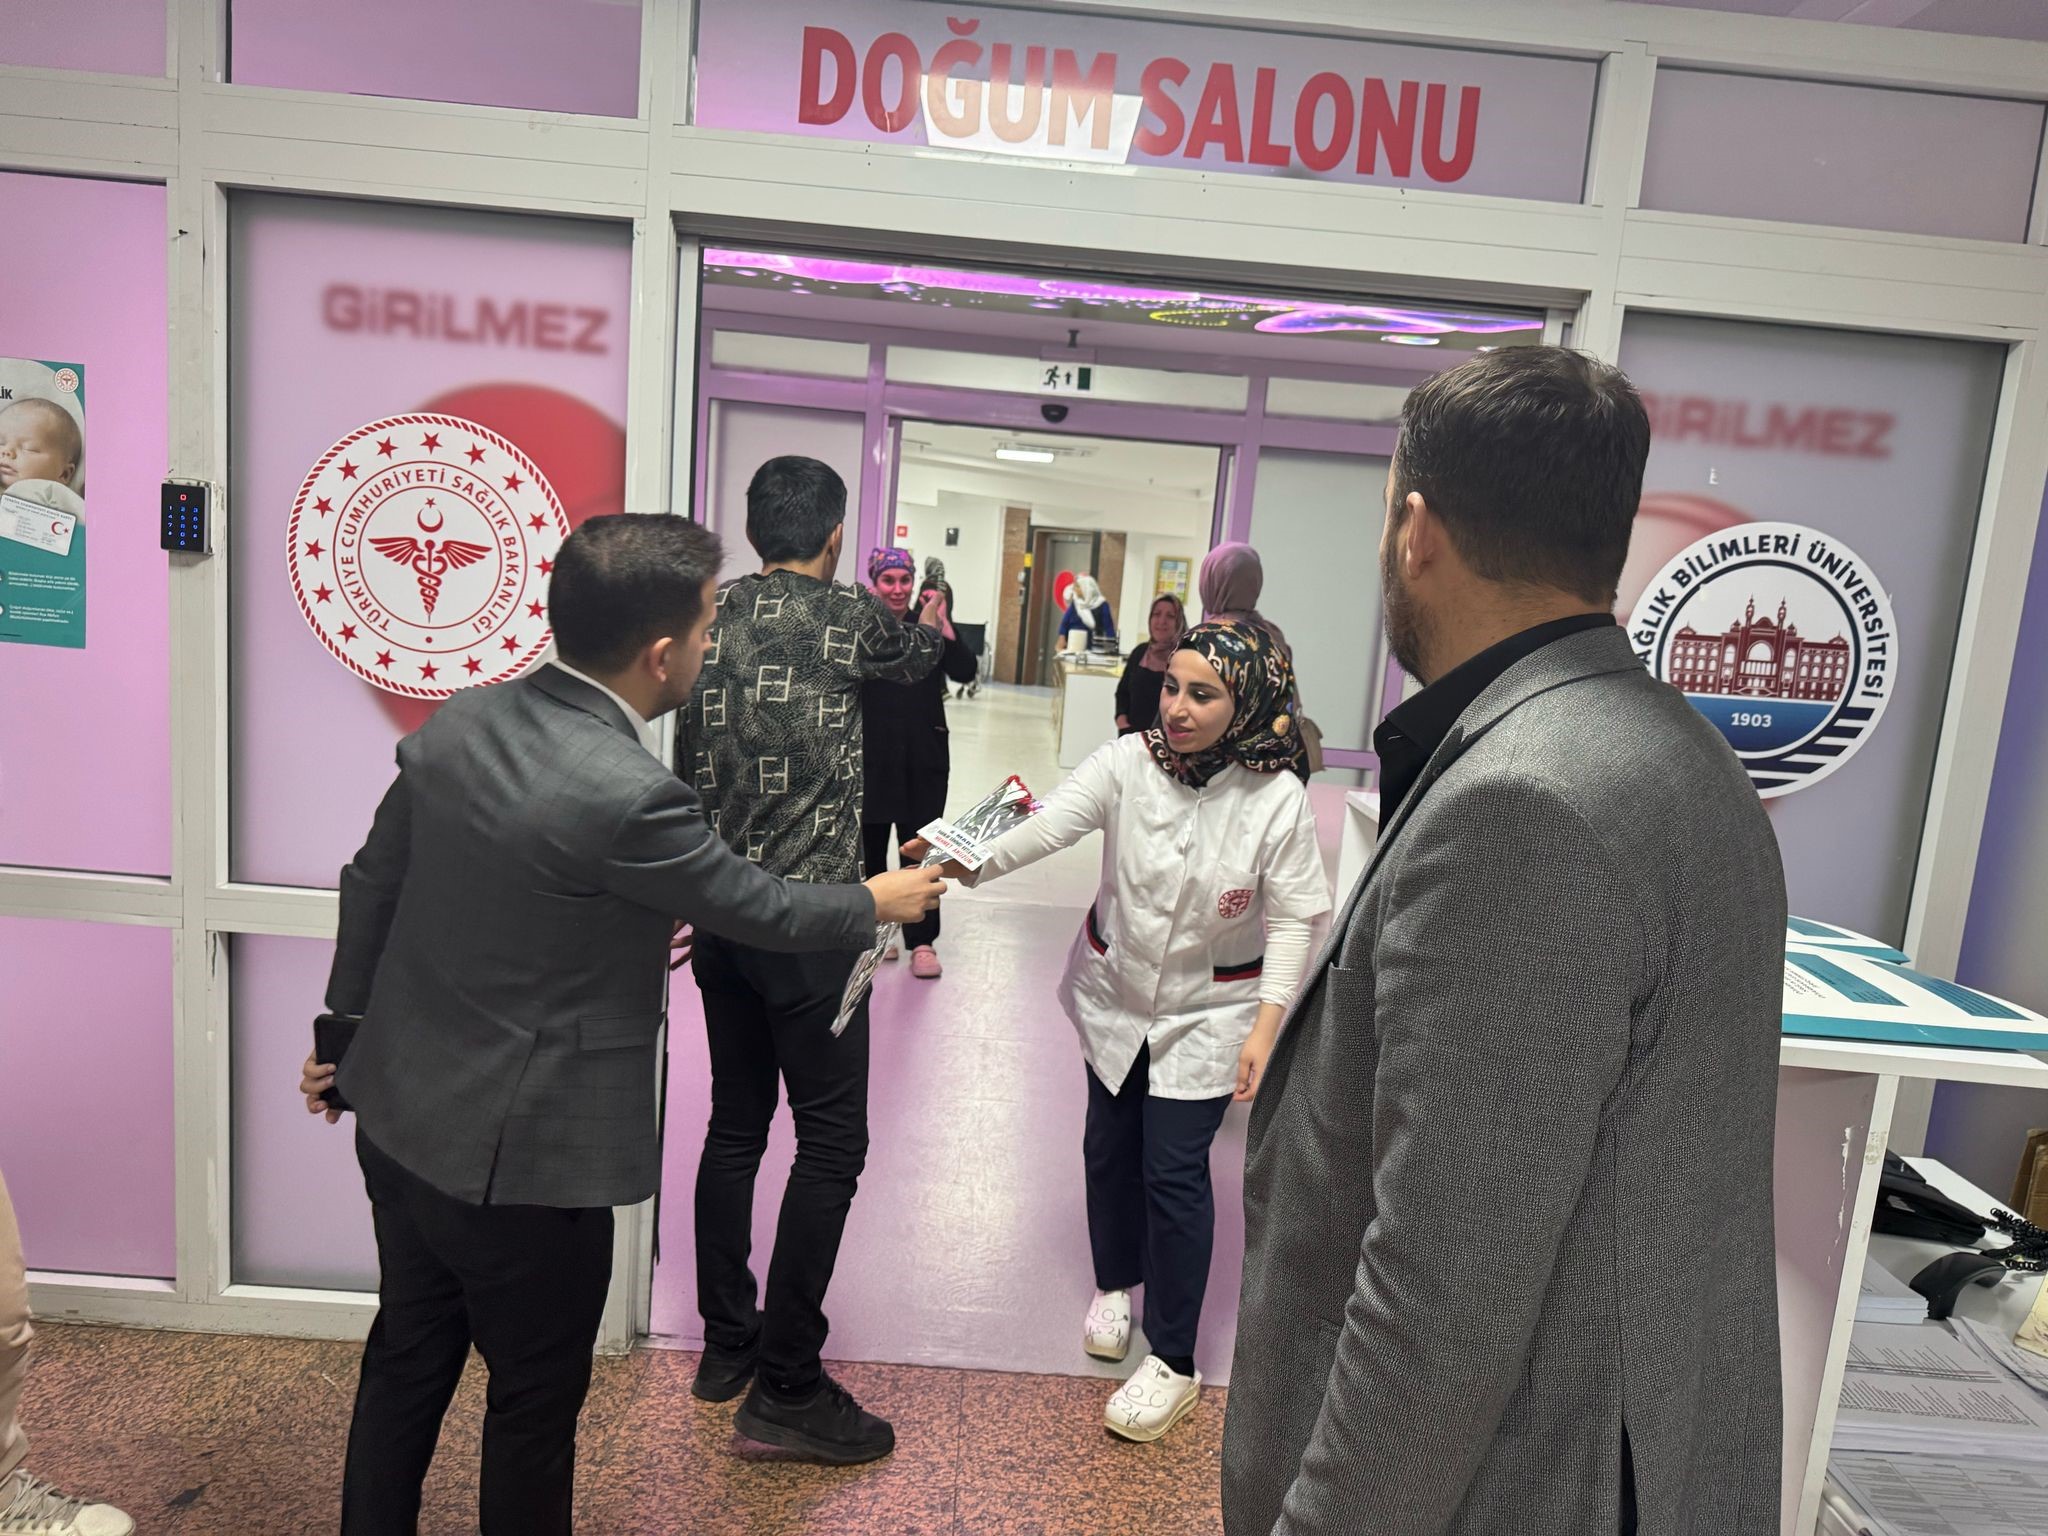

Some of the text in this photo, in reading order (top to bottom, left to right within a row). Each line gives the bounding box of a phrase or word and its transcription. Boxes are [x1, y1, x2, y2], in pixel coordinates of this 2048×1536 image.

[798, 16, 1482, 184] DOĞUM SALONU
[341, 467, 520, 635] TÜRKİYE CUMHURİYETİ SAĞLIK BAKANLIĞI
[1632, 533, 1890, 699] AĞLIK BİLİMLERİ ÜNİVERSİTESİ
[1731, 712, 1772, 728] 1903
